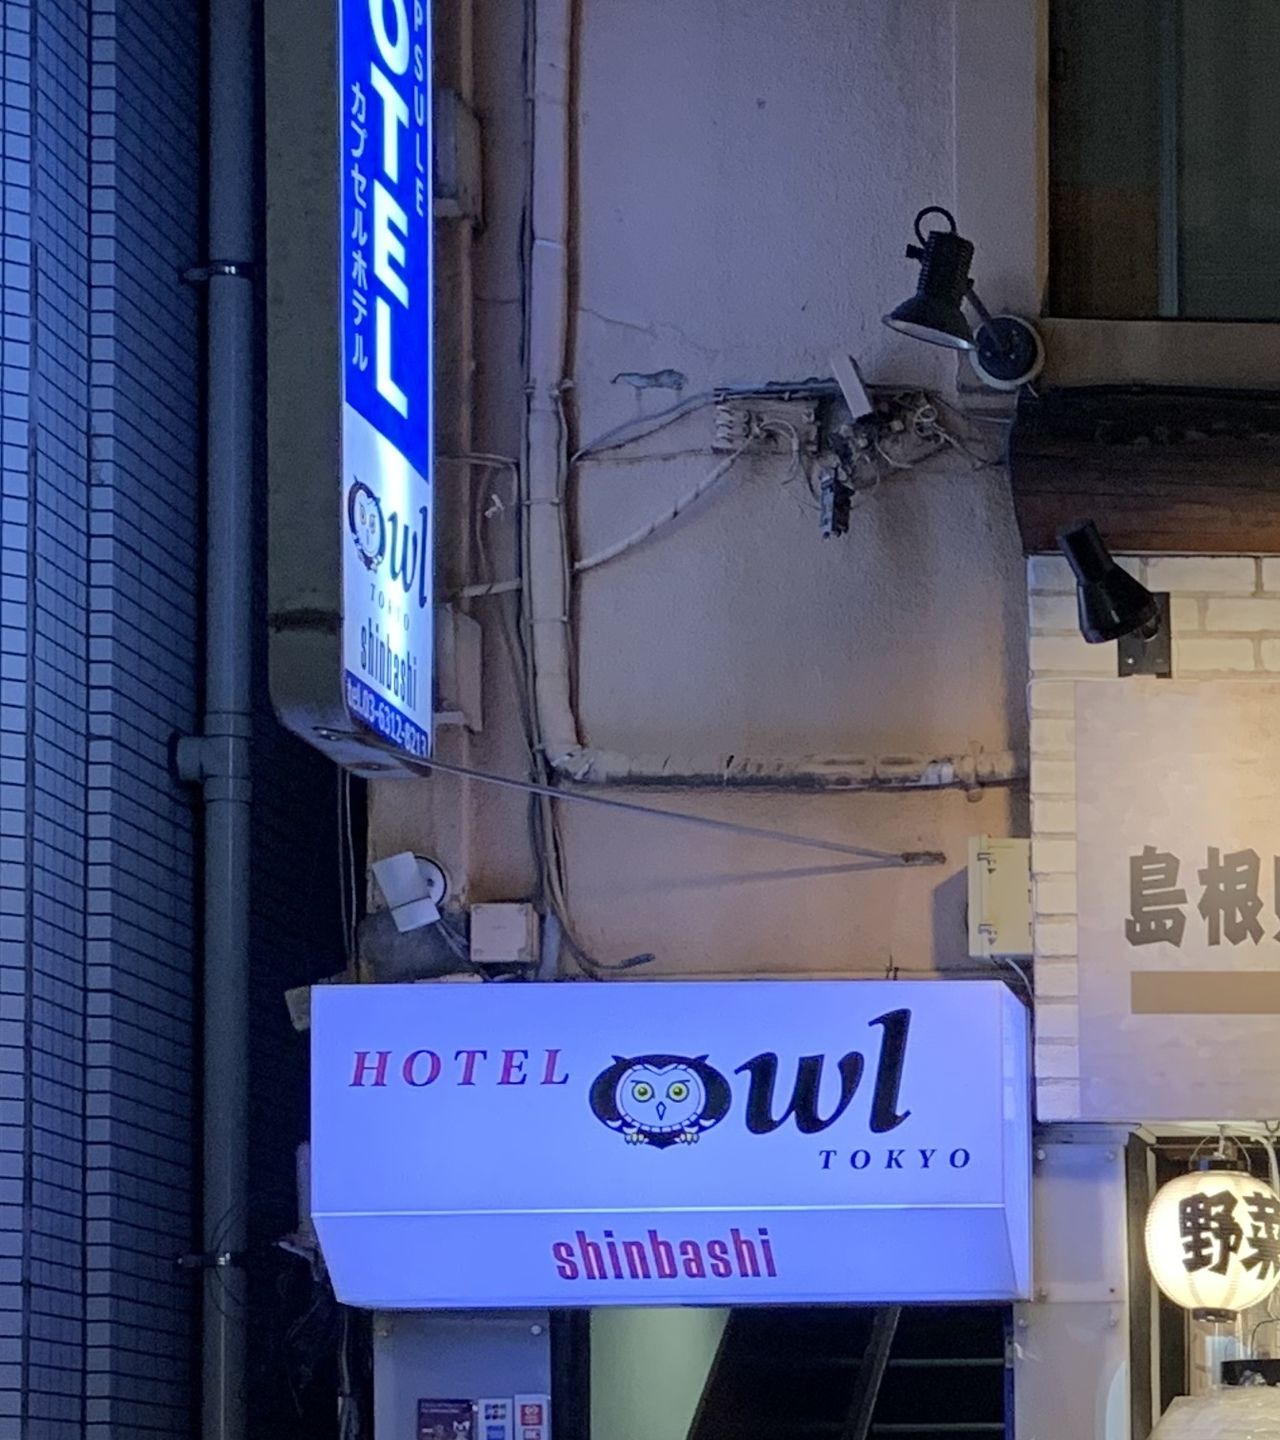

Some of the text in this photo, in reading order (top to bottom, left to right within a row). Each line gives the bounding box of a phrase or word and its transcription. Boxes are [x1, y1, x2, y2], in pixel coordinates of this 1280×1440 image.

[350, 81, 369, 372] カプセルホテル
[360, 616, 418, 712] shinbashi
[349, 1047, 571, 1088] HOTEL
[818, 1147, 972, 1171] TOKYO
[552, 1227, 778, 1281] shinbashi
